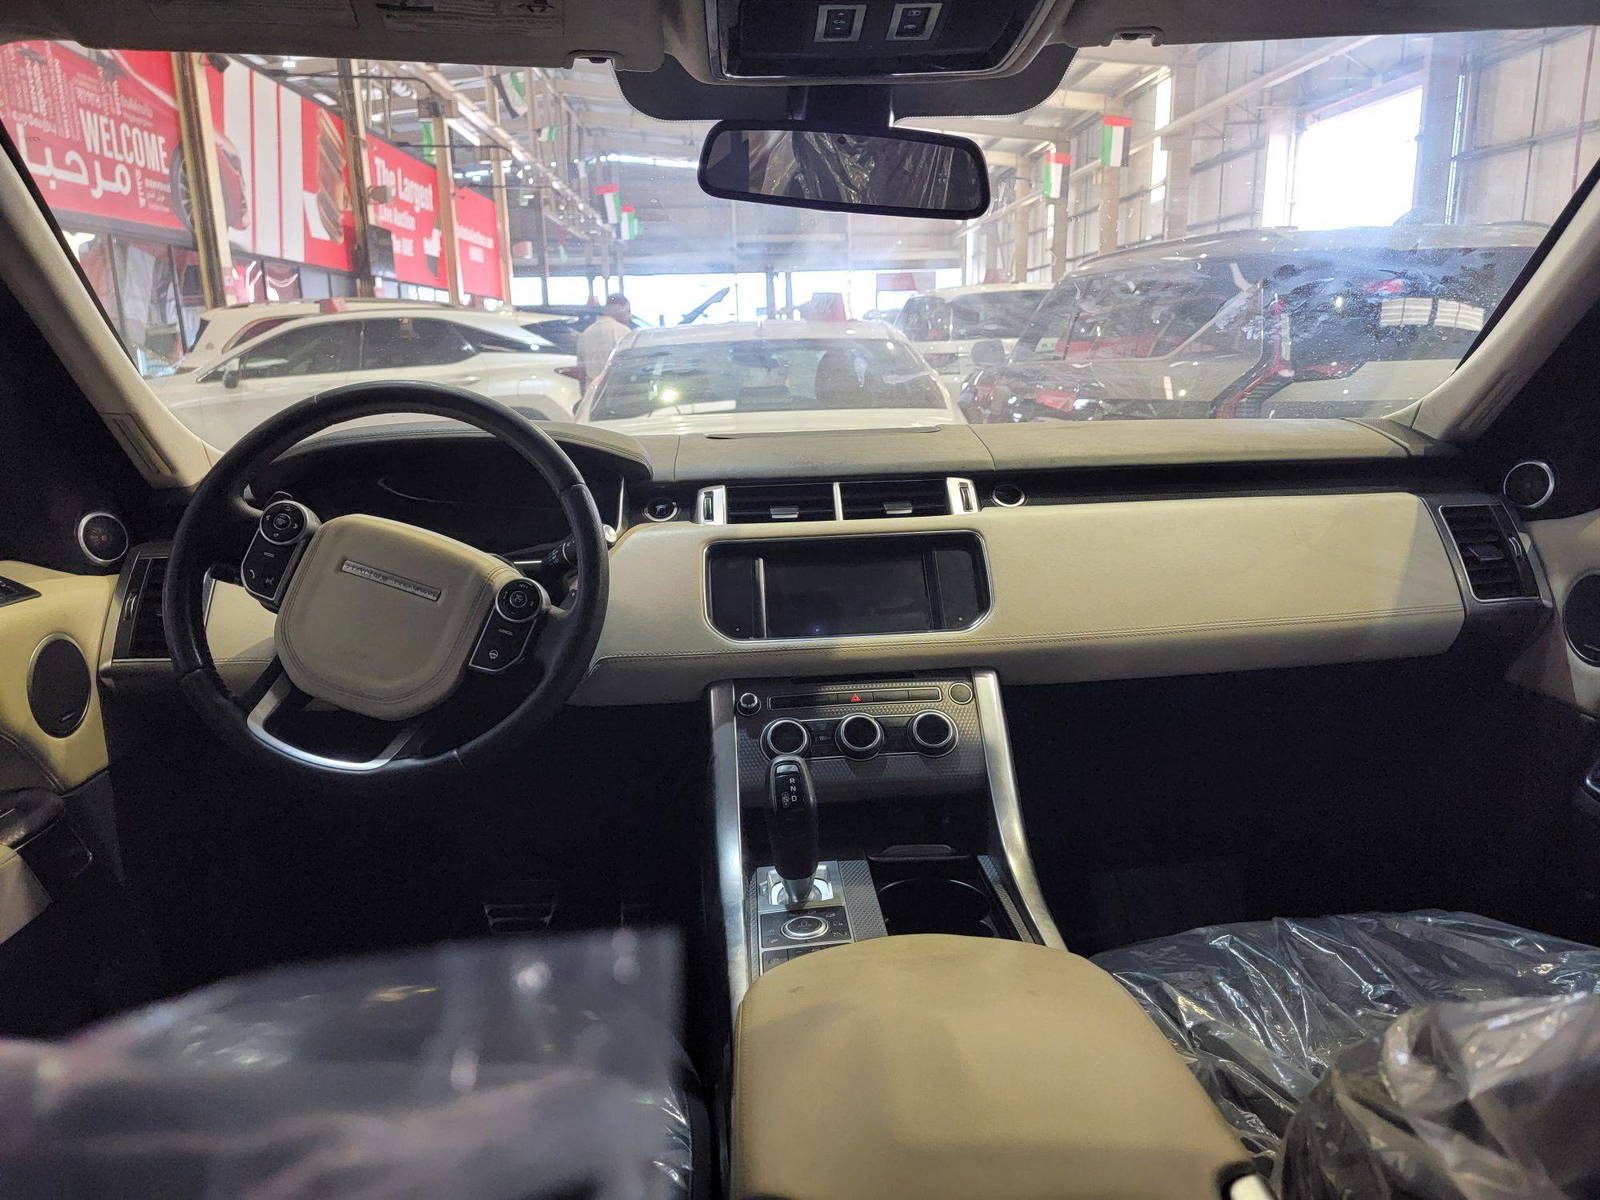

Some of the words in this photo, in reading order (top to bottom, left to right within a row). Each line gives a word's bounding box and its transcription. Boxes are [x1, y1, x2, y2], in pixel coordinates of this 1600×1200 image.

[17, 123, 131, 199] مرحبا
[80, 109, 169, 174] WELCOME
[374, 155, 396, 198] The
